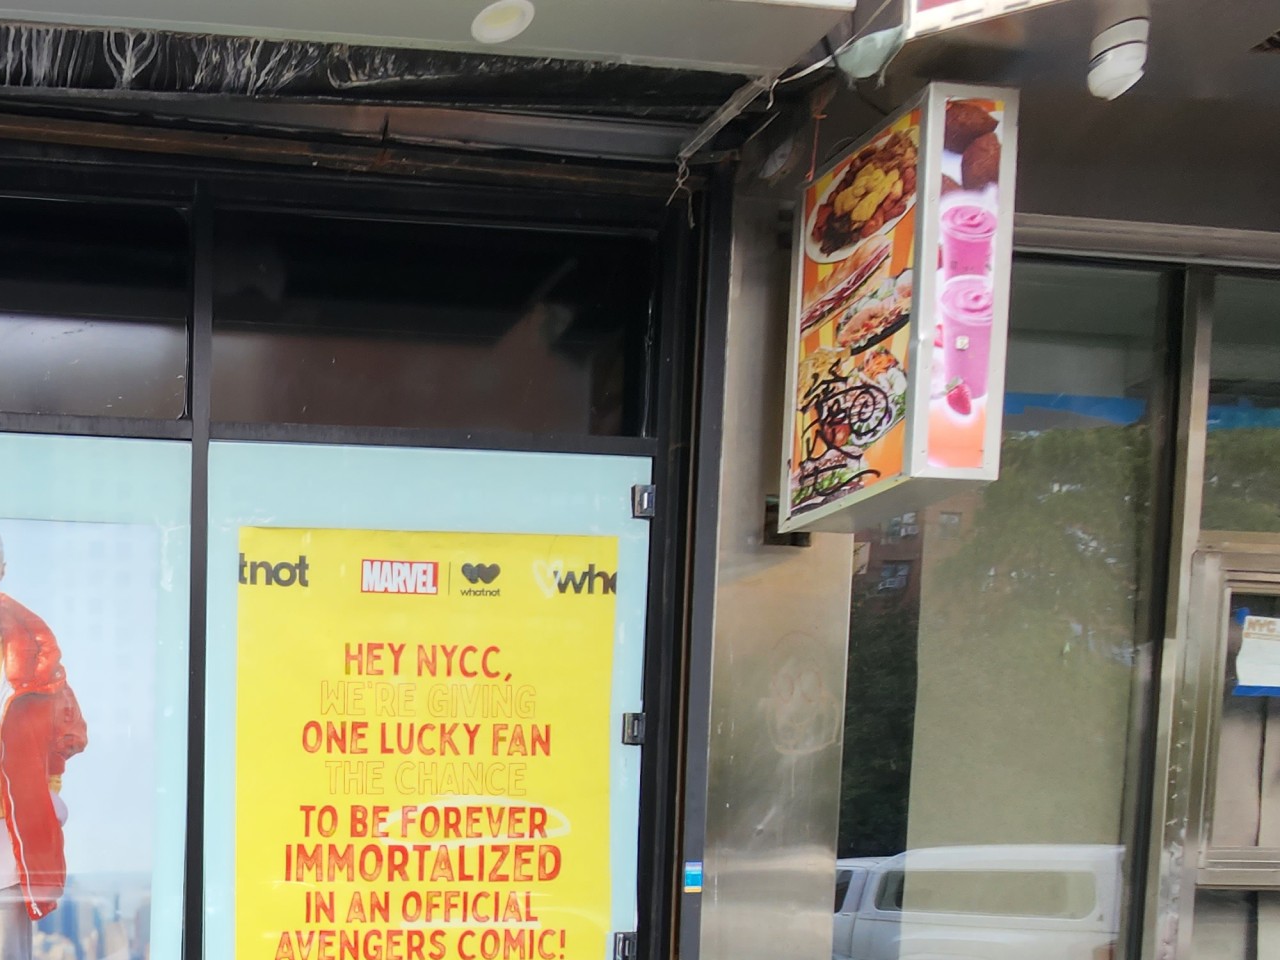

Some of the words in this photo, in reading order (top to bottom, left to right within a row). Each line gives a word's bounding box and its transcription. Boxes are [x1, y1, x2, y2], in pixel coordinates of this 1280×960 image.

[362, 560, 437, 593] MARVEL
[460, 588, 501, 597] whatnot
[344, 642, 406, 676] HEY
[417, 644, 513, 682] NYCC,
[320, 680, 417, 717] WE'RE
[427, 683, 537, 719] GIVING
[301, 720, 369, 754] ONE
[380, 722, 481, 756] LUCKY
[491, 723, 551, 756] FAN
[325, 760, 385, 795] THE
[394, 761, 527, 796] CHANCE
[299, 805, 338, 838] TO
[350, 805, 390, 838] BE
[401, 805, 548, 839] FOREVER
[284, 843, 562, 882] IMMORTALIZED
[305, 891, 335, 923] IN
[345, 891, 390, 923] AN
[401, 891, 539, 923] OFFICIAL
[457, 929, 566, 960] COMIC!
